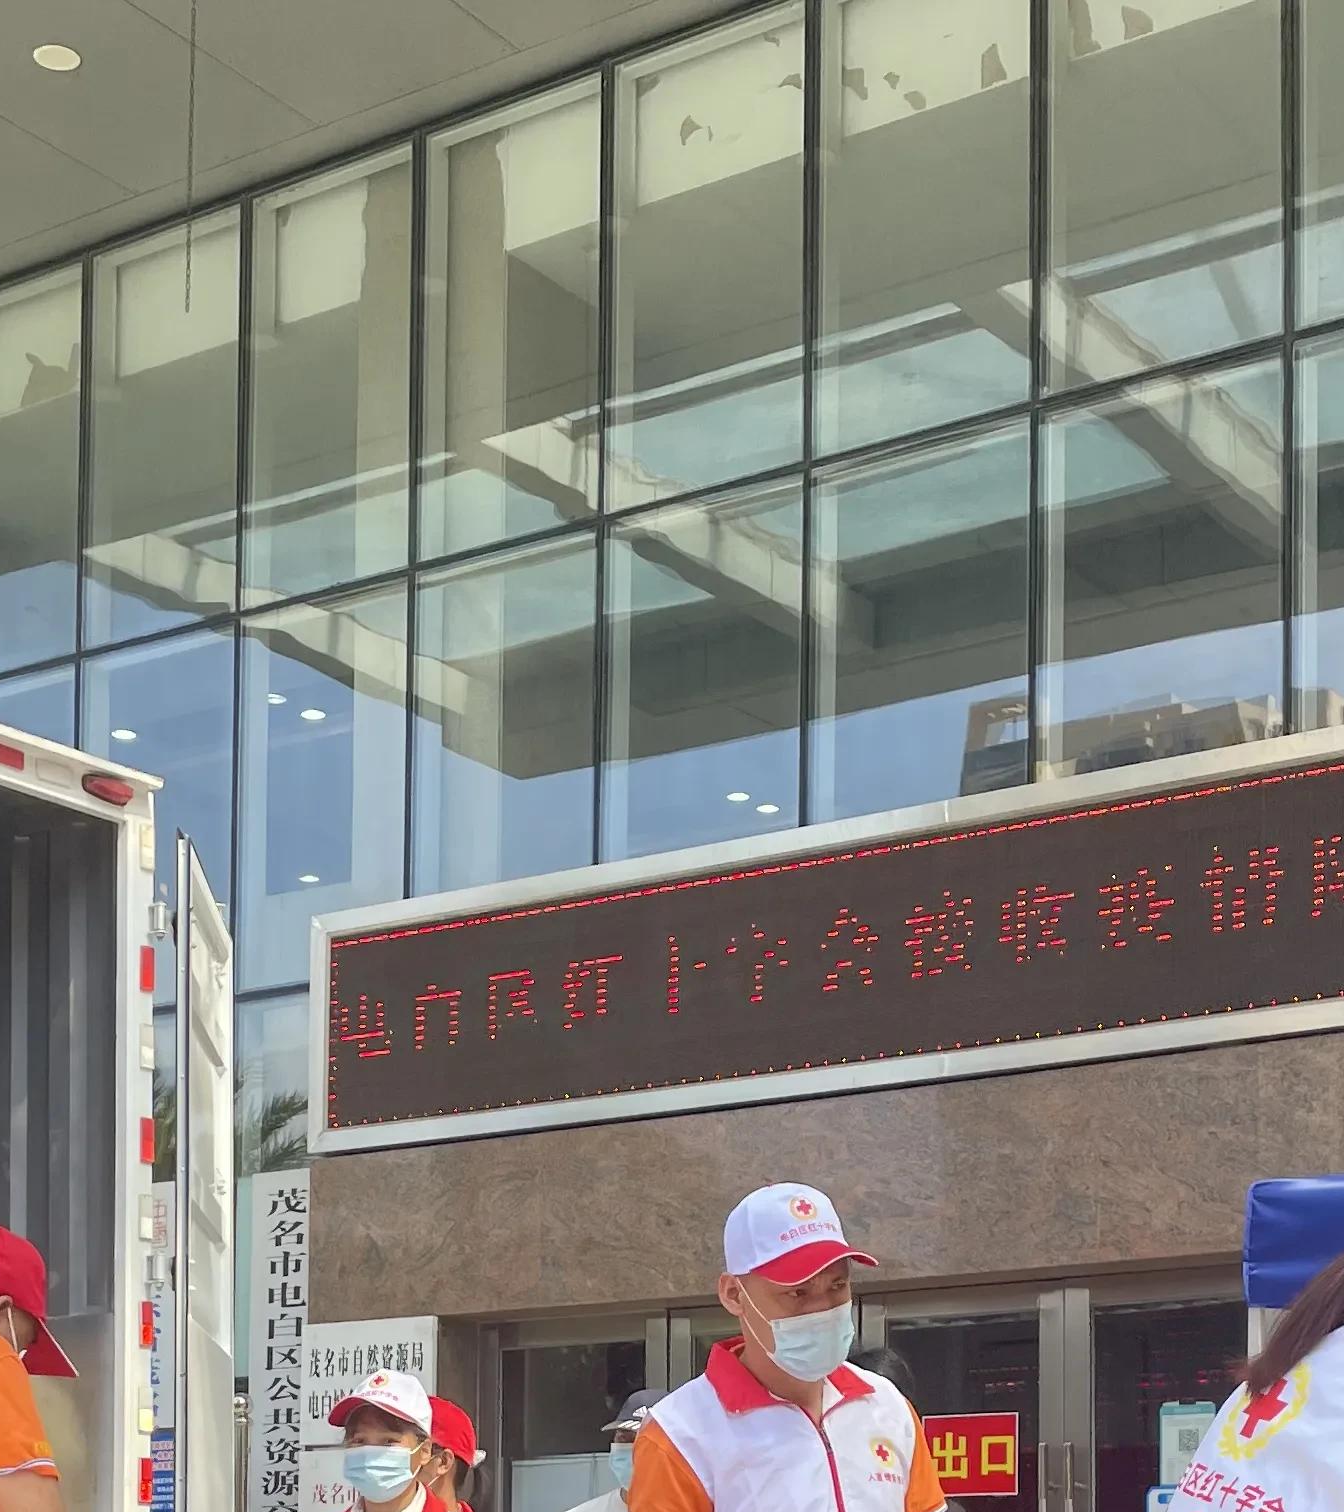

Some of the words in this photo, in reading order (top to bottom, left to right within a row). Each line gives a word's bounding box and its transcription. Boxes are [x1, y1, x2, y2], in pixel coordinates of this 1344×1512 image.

[308, 1342, 424, 1378] 茂名市自然资源局
[932, 1431, 1016, 1480] 出口
